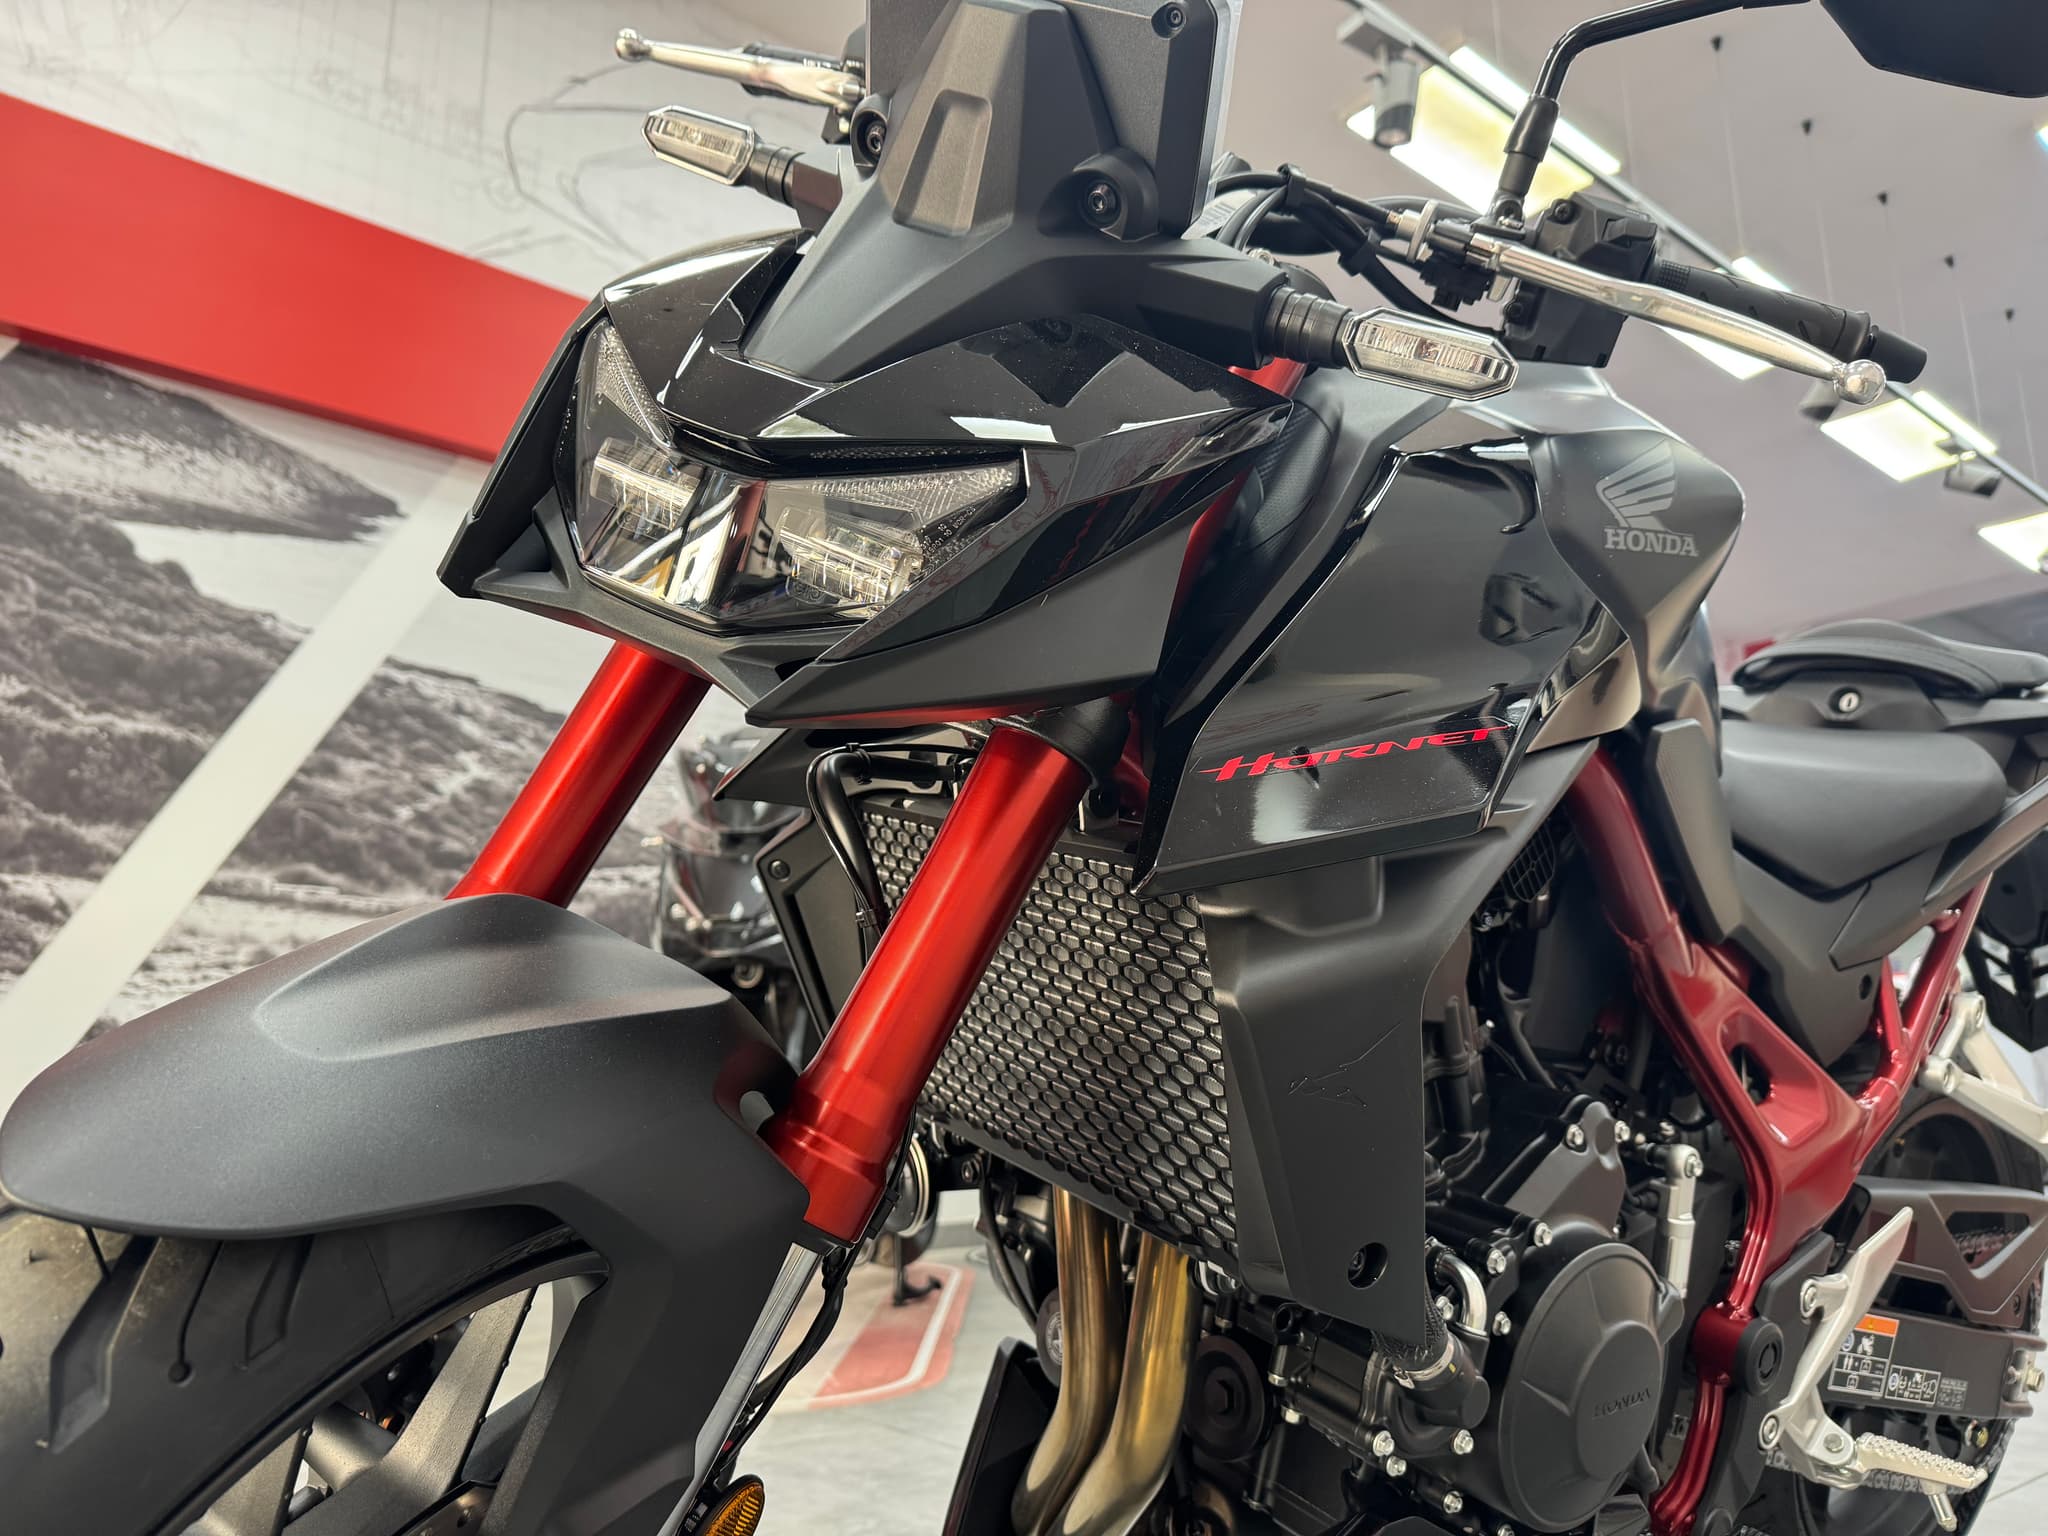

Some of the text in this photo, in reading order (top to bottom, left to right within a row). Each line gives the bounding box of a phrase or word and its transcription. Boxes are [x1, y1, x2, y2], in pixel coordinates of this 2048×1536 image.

[1603, 528, 1699, 557] HONDA
[1199, 725, 1513, 782] HORNET
[1593, 1387, 1651, 1418] HONDA
